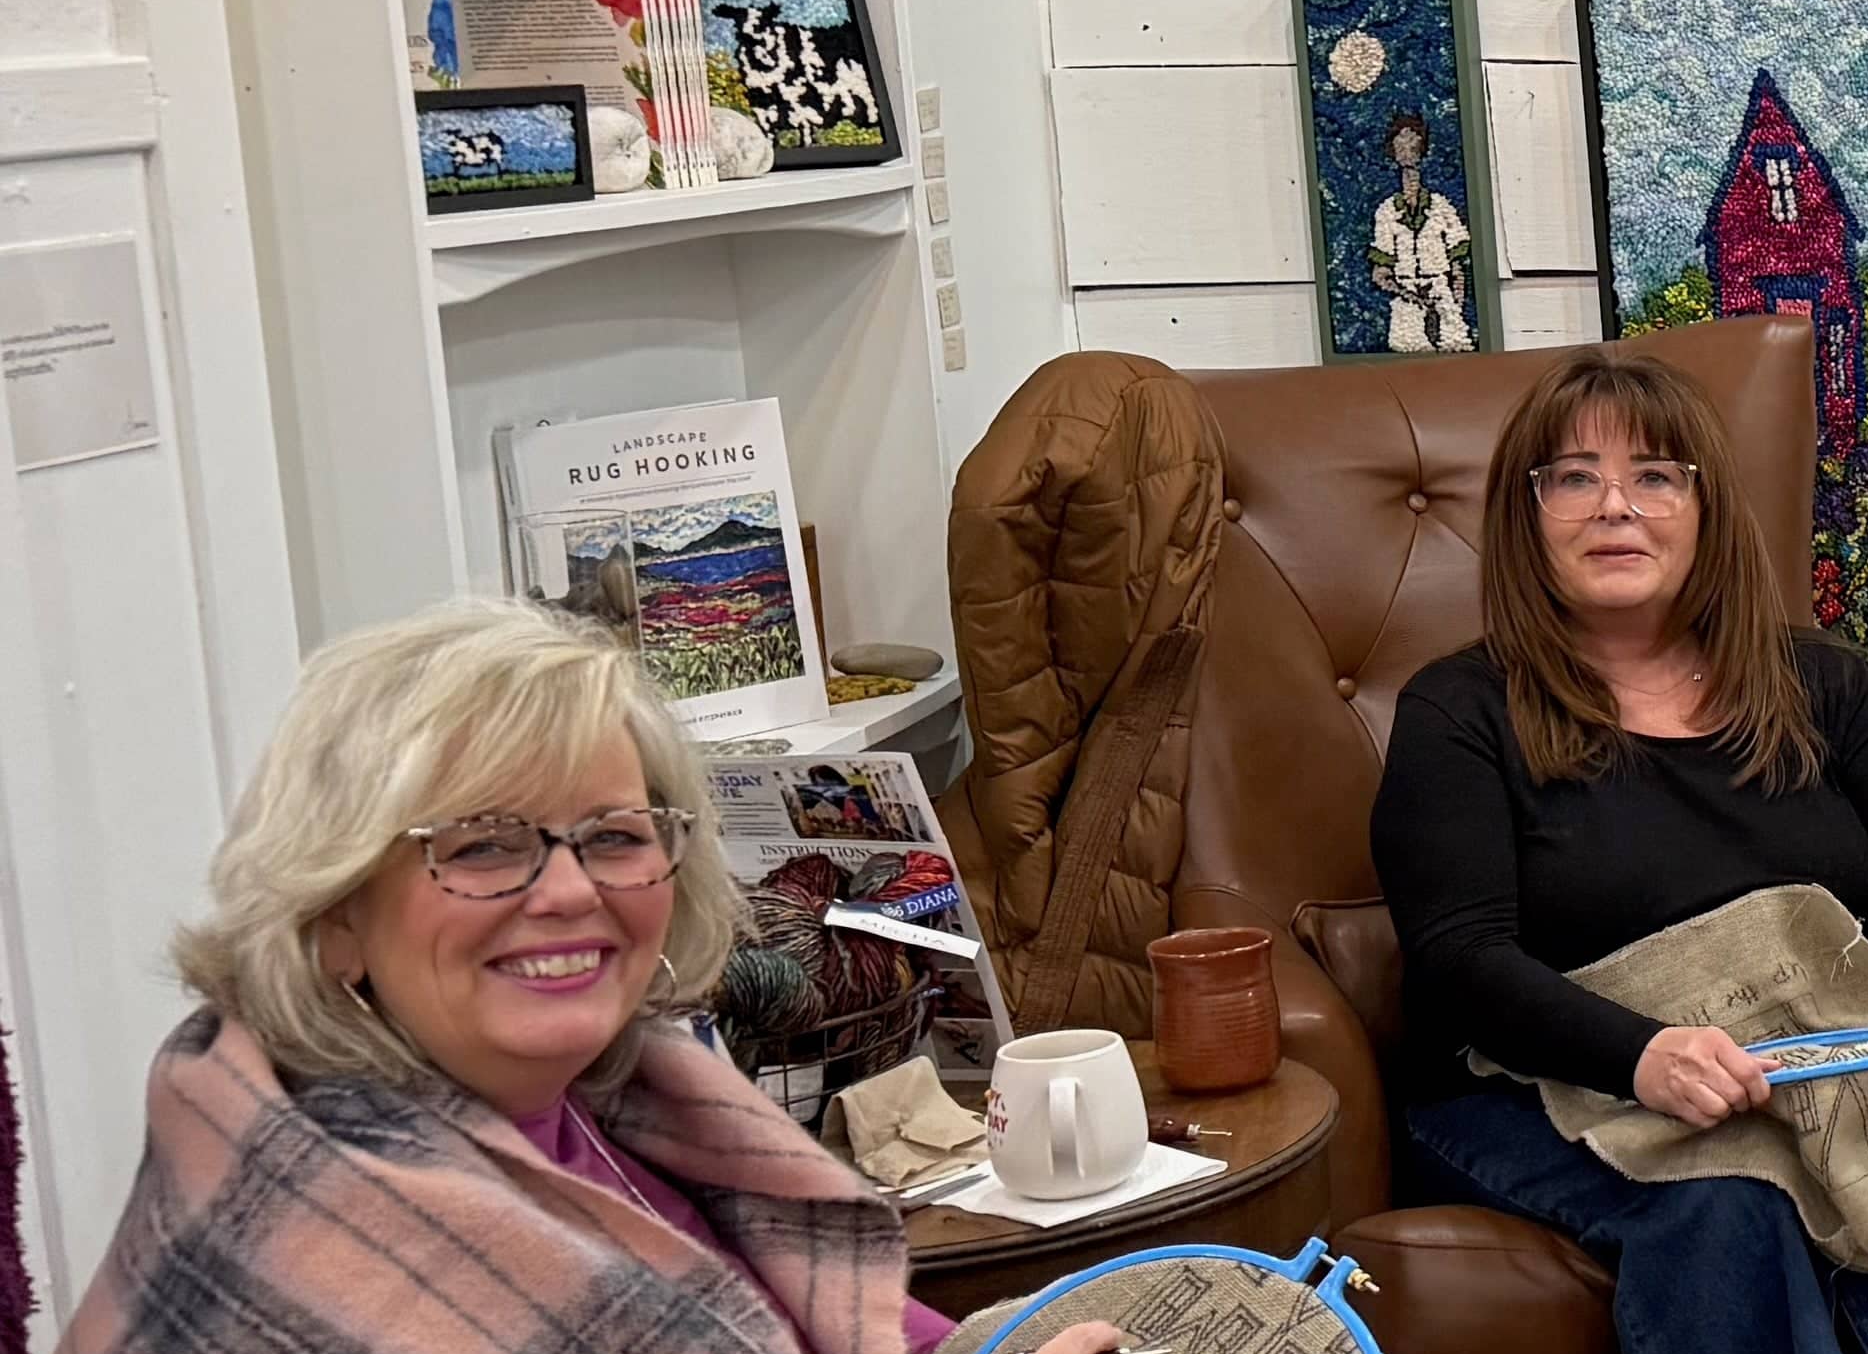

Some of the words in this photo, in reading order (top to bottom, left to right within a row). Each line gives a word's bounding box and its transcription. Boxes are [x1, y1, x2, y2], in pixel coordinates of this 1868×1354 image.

[612, 431, 708, 454] LANDSCAPE
[568, 461, 622, 485] RUG
[635, 444, 756, 477] HOOKING
[905, 887, 958, 915] DIANA
